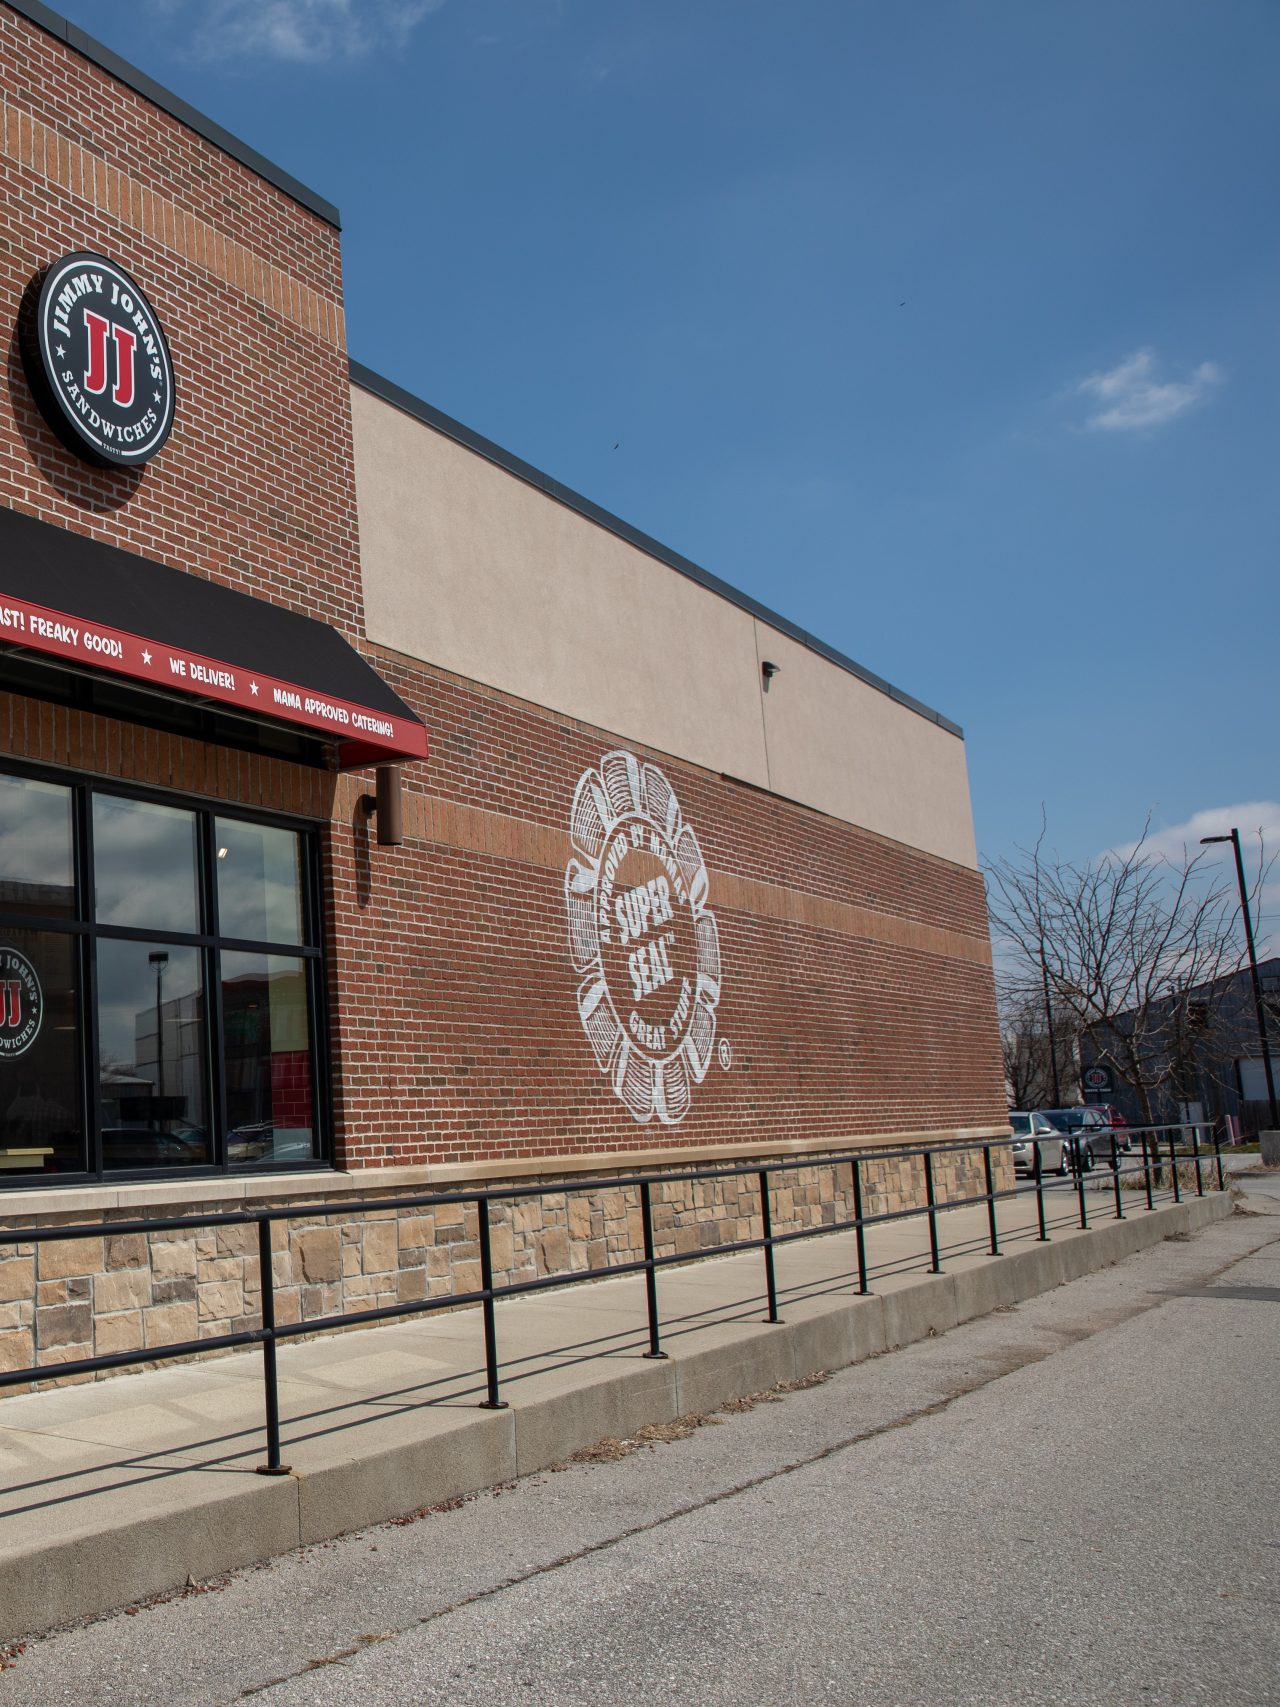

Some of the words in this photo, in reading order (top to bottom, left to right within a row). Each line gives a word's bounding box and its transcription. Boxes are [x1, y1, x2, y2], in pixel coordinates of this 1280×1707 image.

[53, 273, 103, 338] JIMMY
[111, 282, 163, 380] JOHN'S
[83, 307, 137, 408] JJ
[61, 369, 157, 443] SANDWICHES
[29, 615, 79, 646] FREAKY
[83, 632, 123, 659] GOOD!
[169, 656, 186, 676] WE
[189, 662, 235, 691] DELIVER!
[273, 688, 301, 710] MAMA
[304, 697, 349, 724] APPROVED
[352, 713, 394, 738] CATERING!
[600, 832, 628, 943] APPROVED
[630, 824, 644, 848] BY
[615, 875, 675, 945] SUPER
[6, 954, 38, 1002] JOHN'S
[628, 936, 674, 1002] SEAL
[629, 1010, 666, 1051] GREAT
[669, 976, 692, 1040] STUFF
